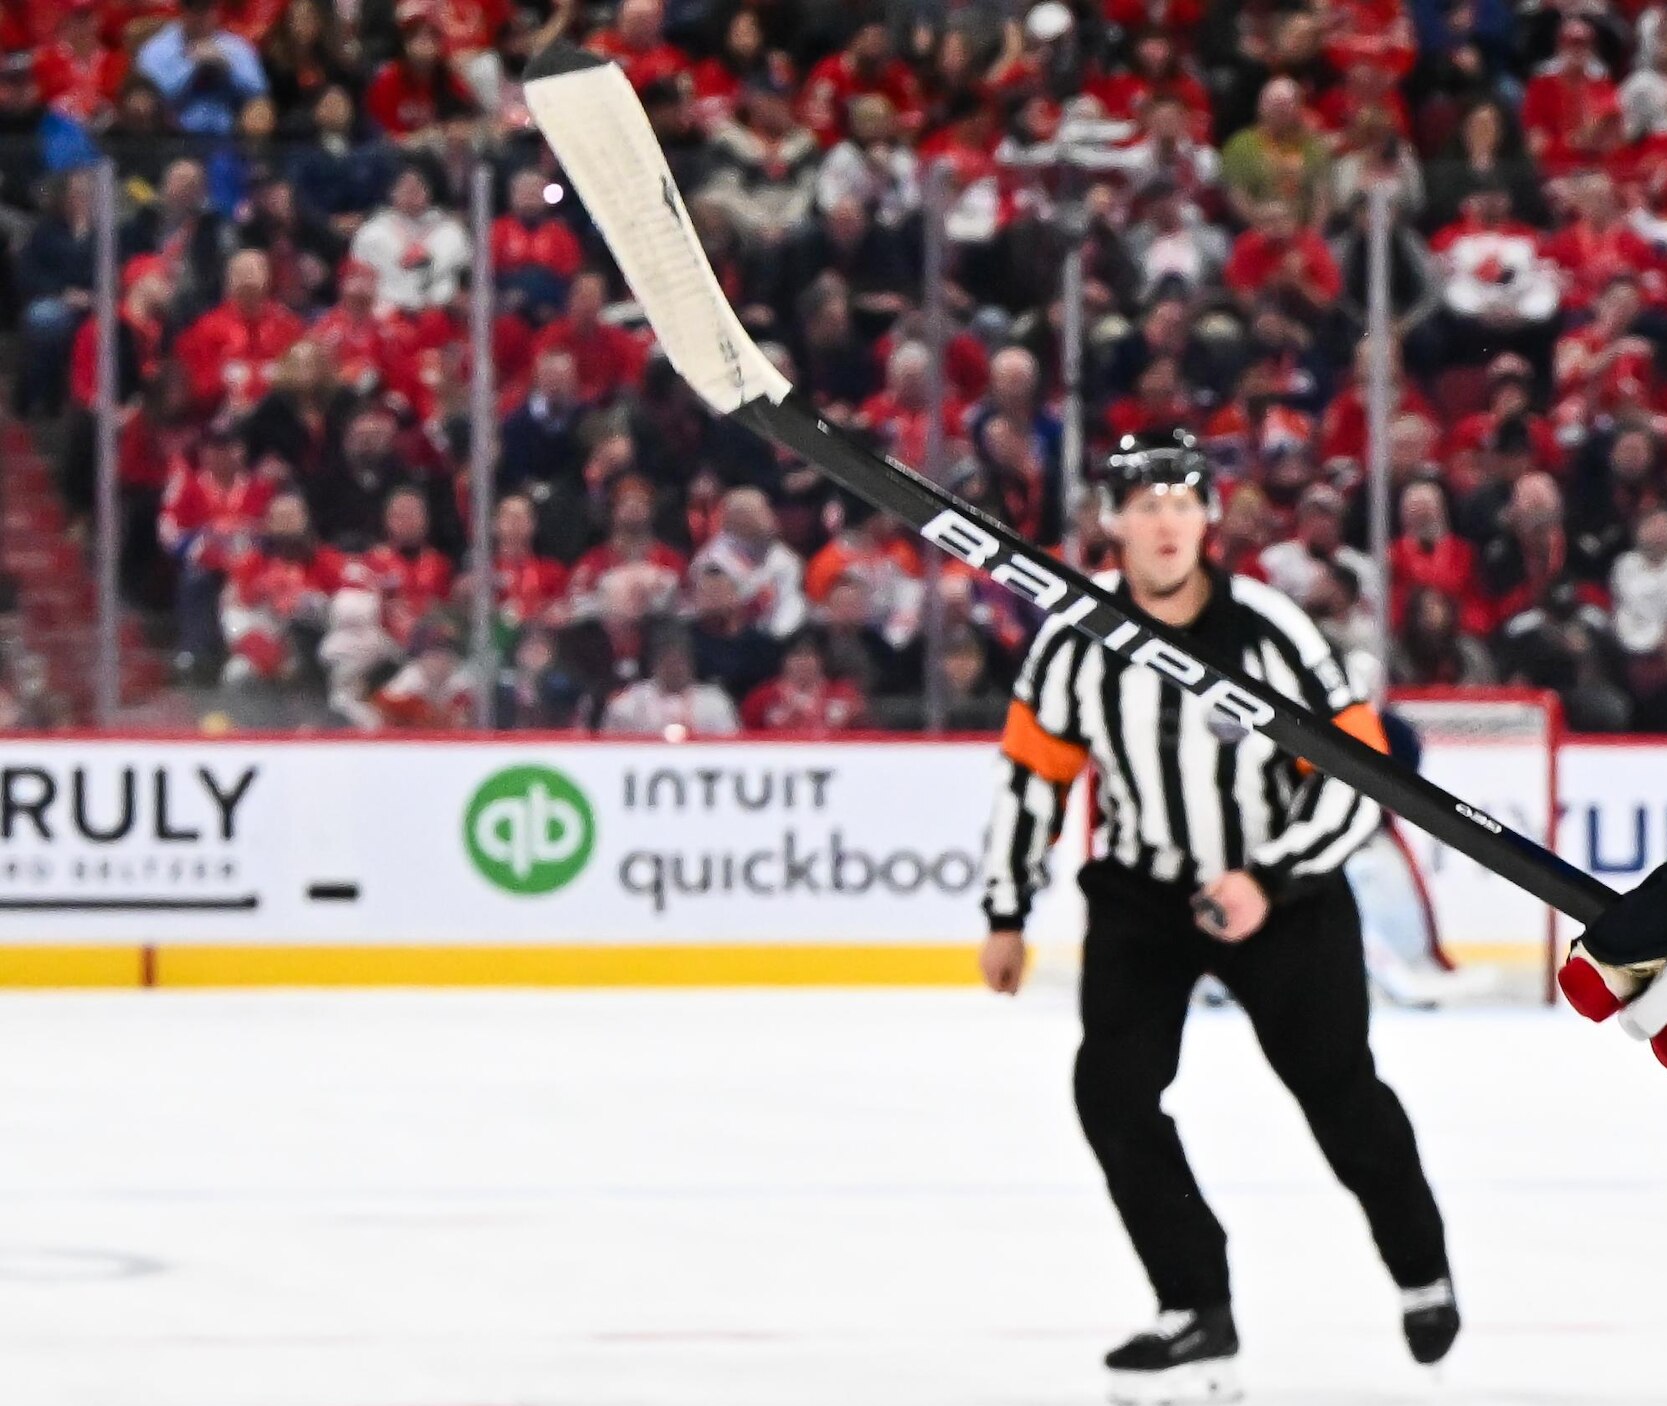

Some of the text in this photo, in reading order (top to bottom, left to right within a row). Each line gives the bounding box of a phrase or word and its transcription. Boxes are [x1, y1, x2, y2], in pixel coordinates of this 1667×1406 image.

[1, 764, 257, 843] RULY
[624, 769, 833, 810] INTUIT
[618, 829, 993, 914] quickboo
